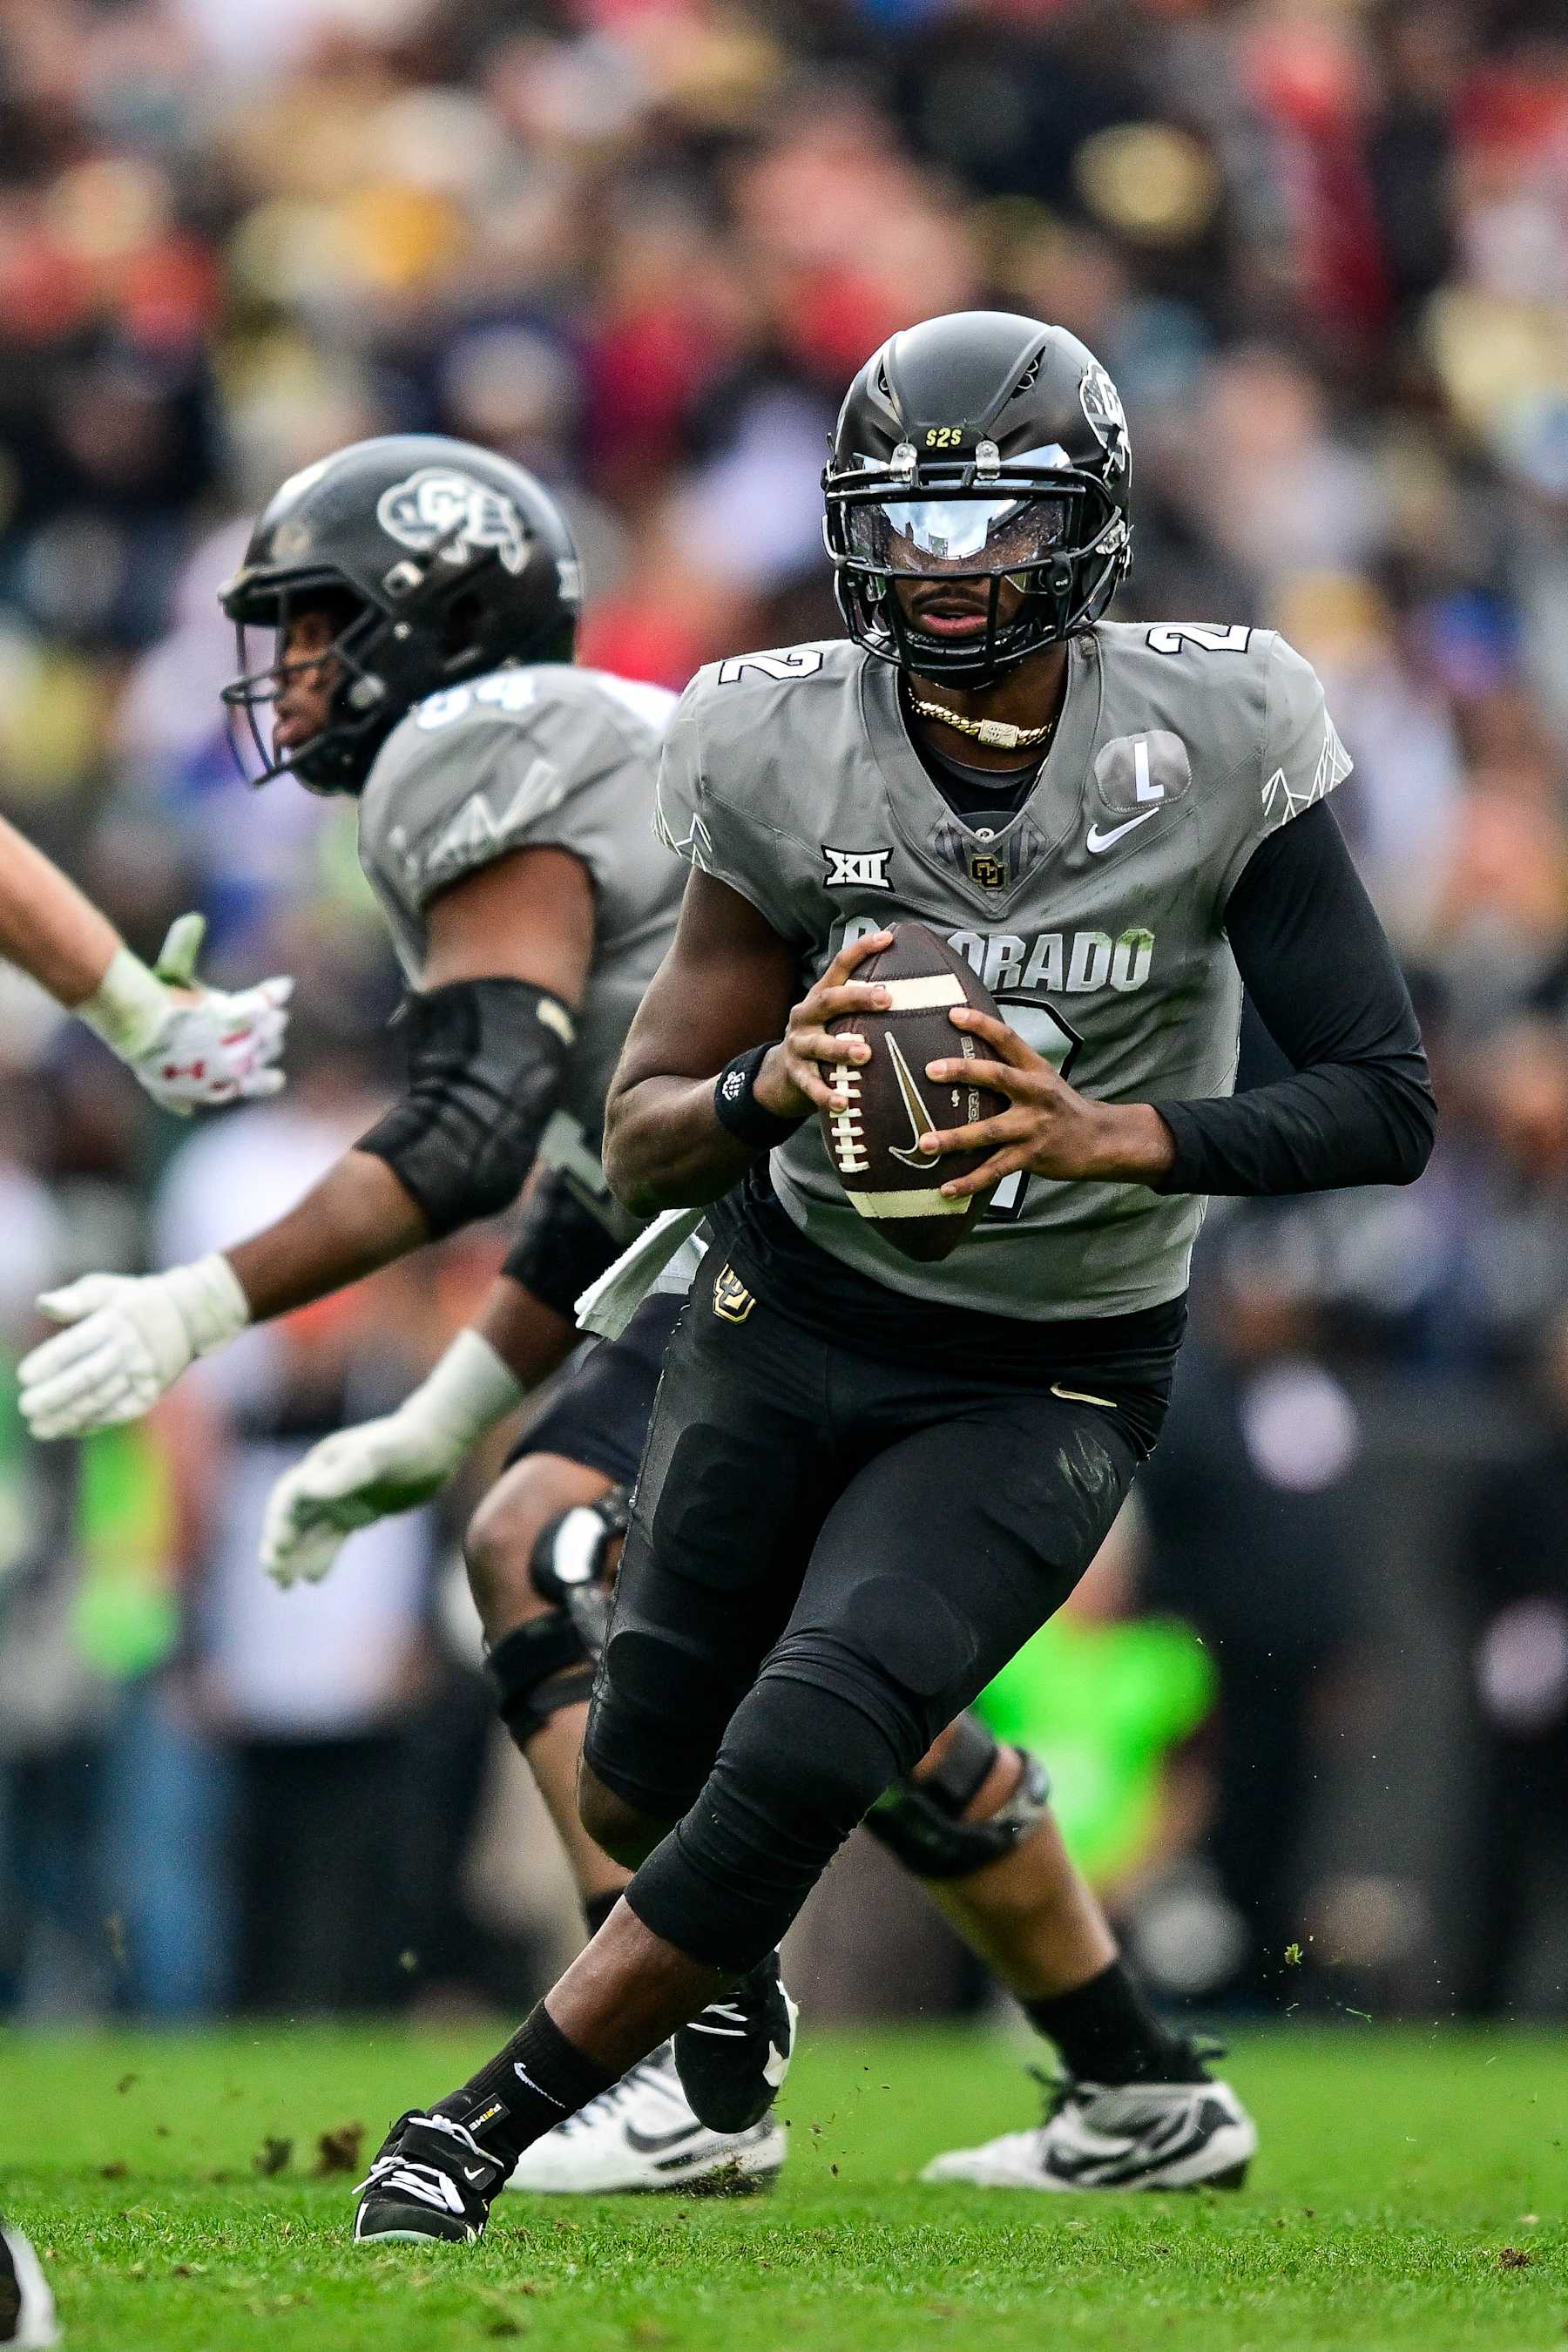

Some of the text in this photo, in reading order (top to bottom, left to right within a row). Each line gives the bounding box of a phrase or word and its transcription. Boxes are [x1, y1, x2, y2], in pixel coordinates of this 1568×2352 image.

[1146, 625, 1254, 654] 2
[718, 649, 824, 686] 2
[1134, 741, 1165, 802] L
[468, 2103, 503, 2132] PRIME
